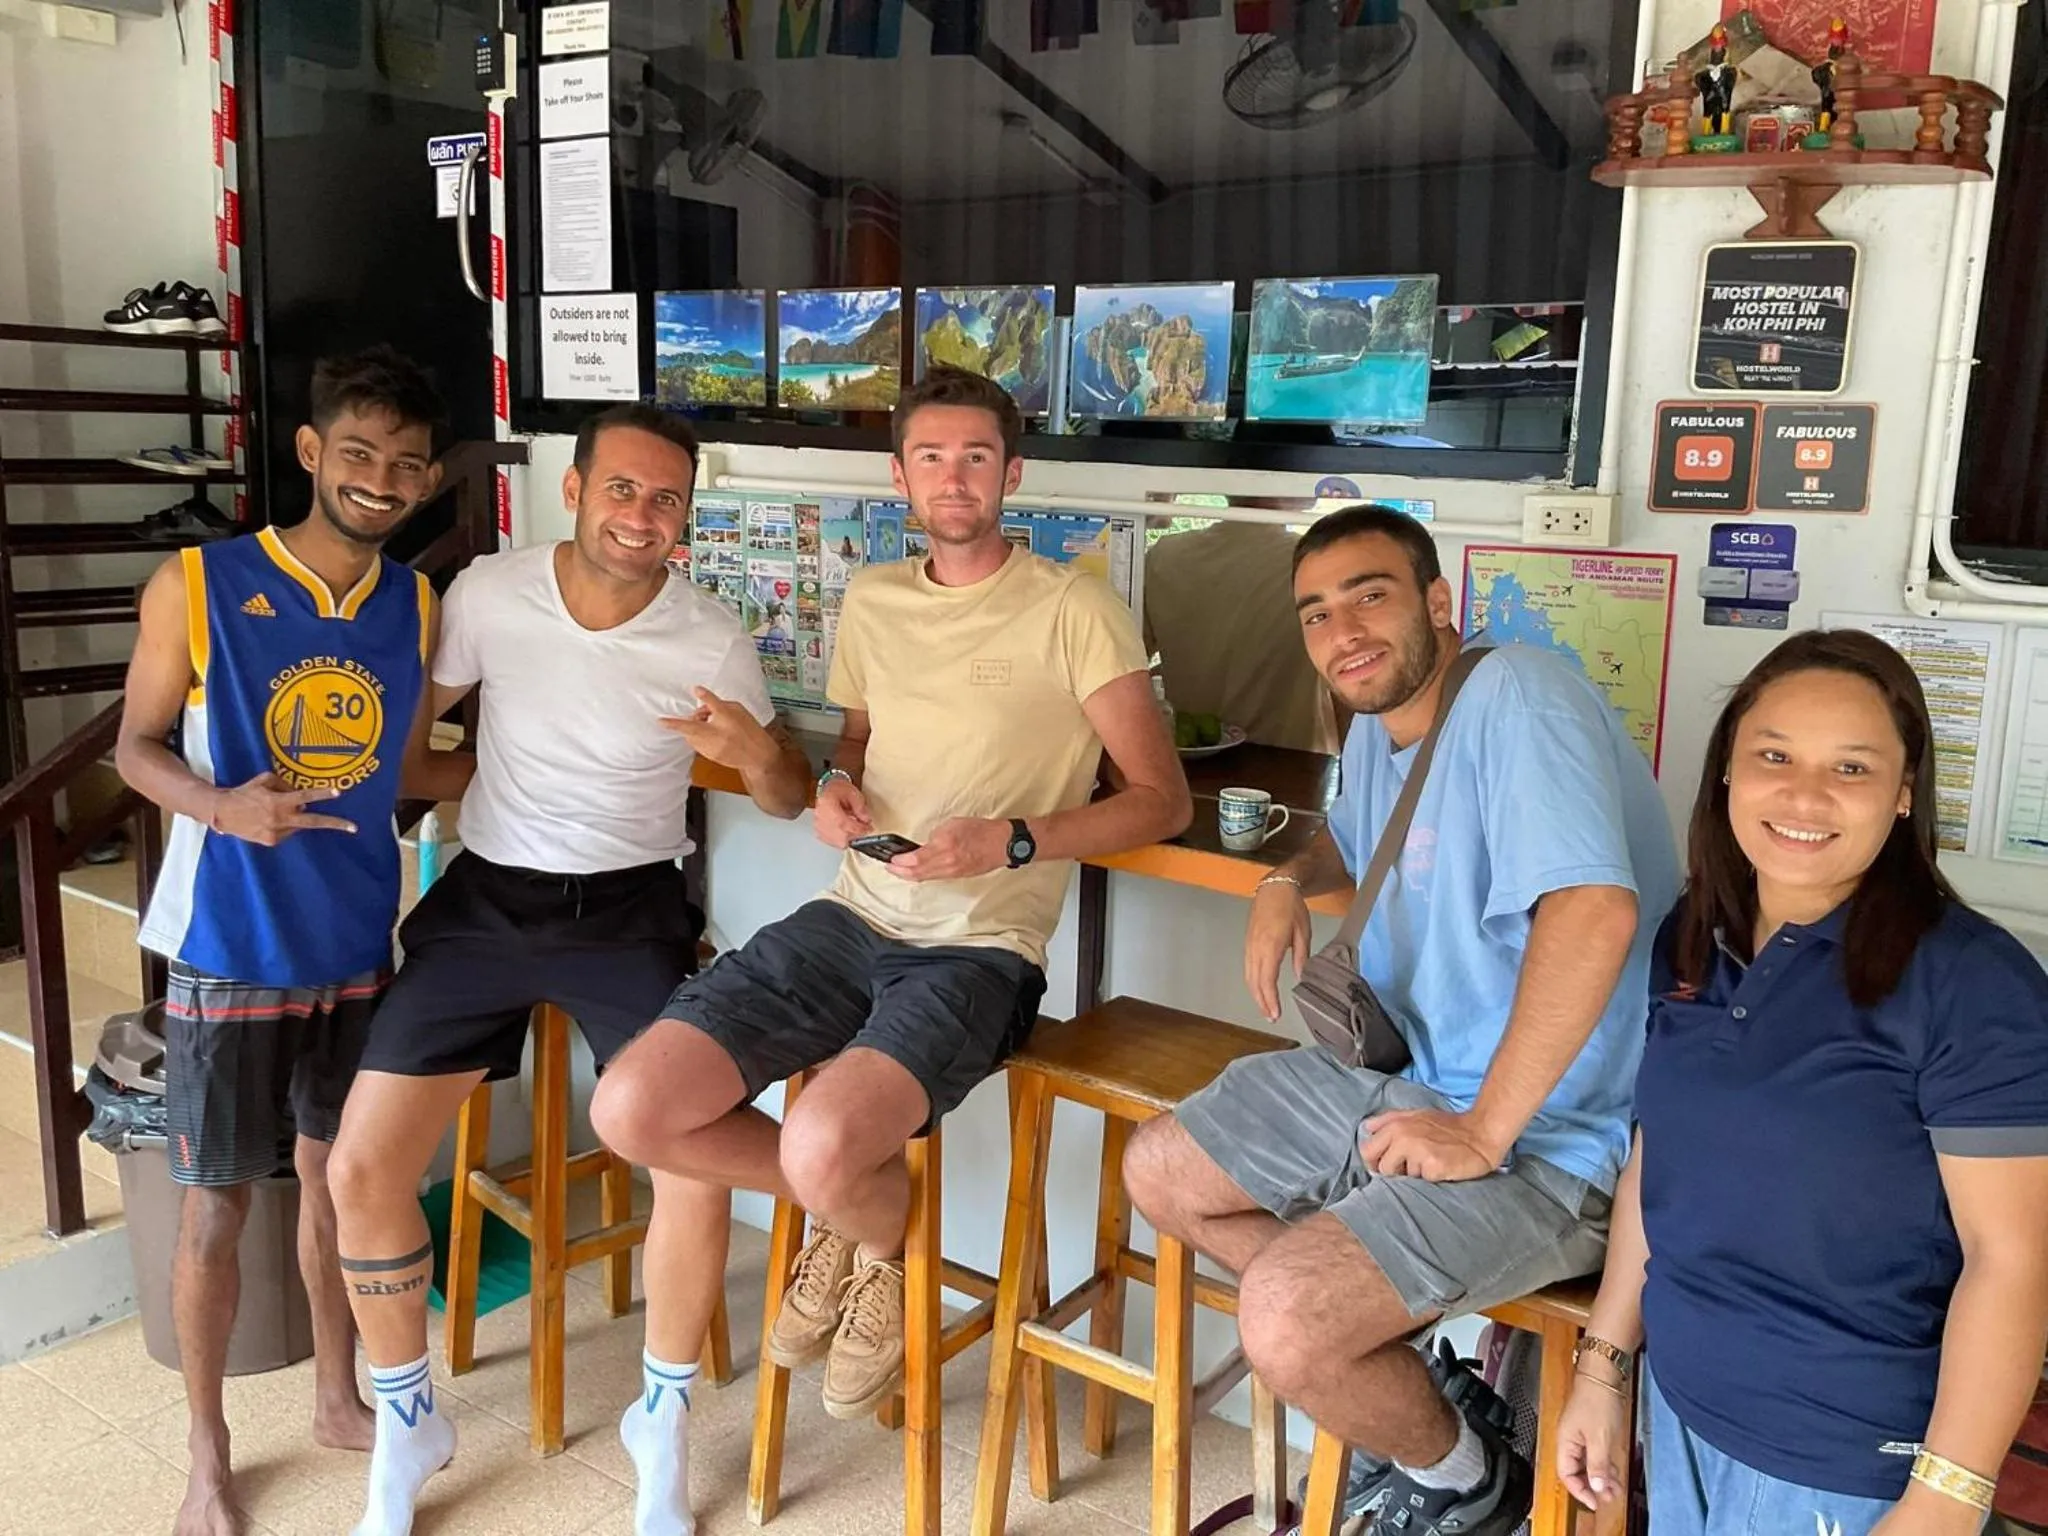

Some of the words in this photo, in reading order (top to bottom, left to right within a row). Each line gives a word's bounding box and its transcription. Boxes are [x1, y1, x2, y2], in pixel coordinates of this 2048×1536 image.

[1712, 286, 1763, 300] MOST
[1763, 286, 1846, 300] POPULAR
[550, 307, 594, 320] Outsiders
[596, 309, 611, 320] are
[613, 308, 630, 320] not
[1732, 302, 1796, 316] HOSTEL
[1799, 302, 1821, 315] IN
[1723, 317, 1761, 331] KOH
[1762, 317, 1793, 331] PHI
[1794, 317, 1827, 331] PHI
[552, 329, 589, 342] allowed
[590, 331, 601, 342] to
[602, 329, 628, 345] bring
[574, 351, 605, 365] inside.
[1736, 365, 1801, 373] HOSTELWORLD
[1670, 416, 1744, 428] FABULOUS
[1776, 426, 1858, 439] FABULOUS
[1684, 449, 1724, 468] 8.9
[1800, 448, 1826, 461] 8.9
[1730, 531, 1760, 545] SCB
[1572, 558, 1614, 574] TIGERLINE
[1589, 574, 1634, 582] ANDAMAN
[269, 655, 339, 690] GOLDEN
[343, 658, 387, 696] STATE
[324, 691, 366, 721] 30
